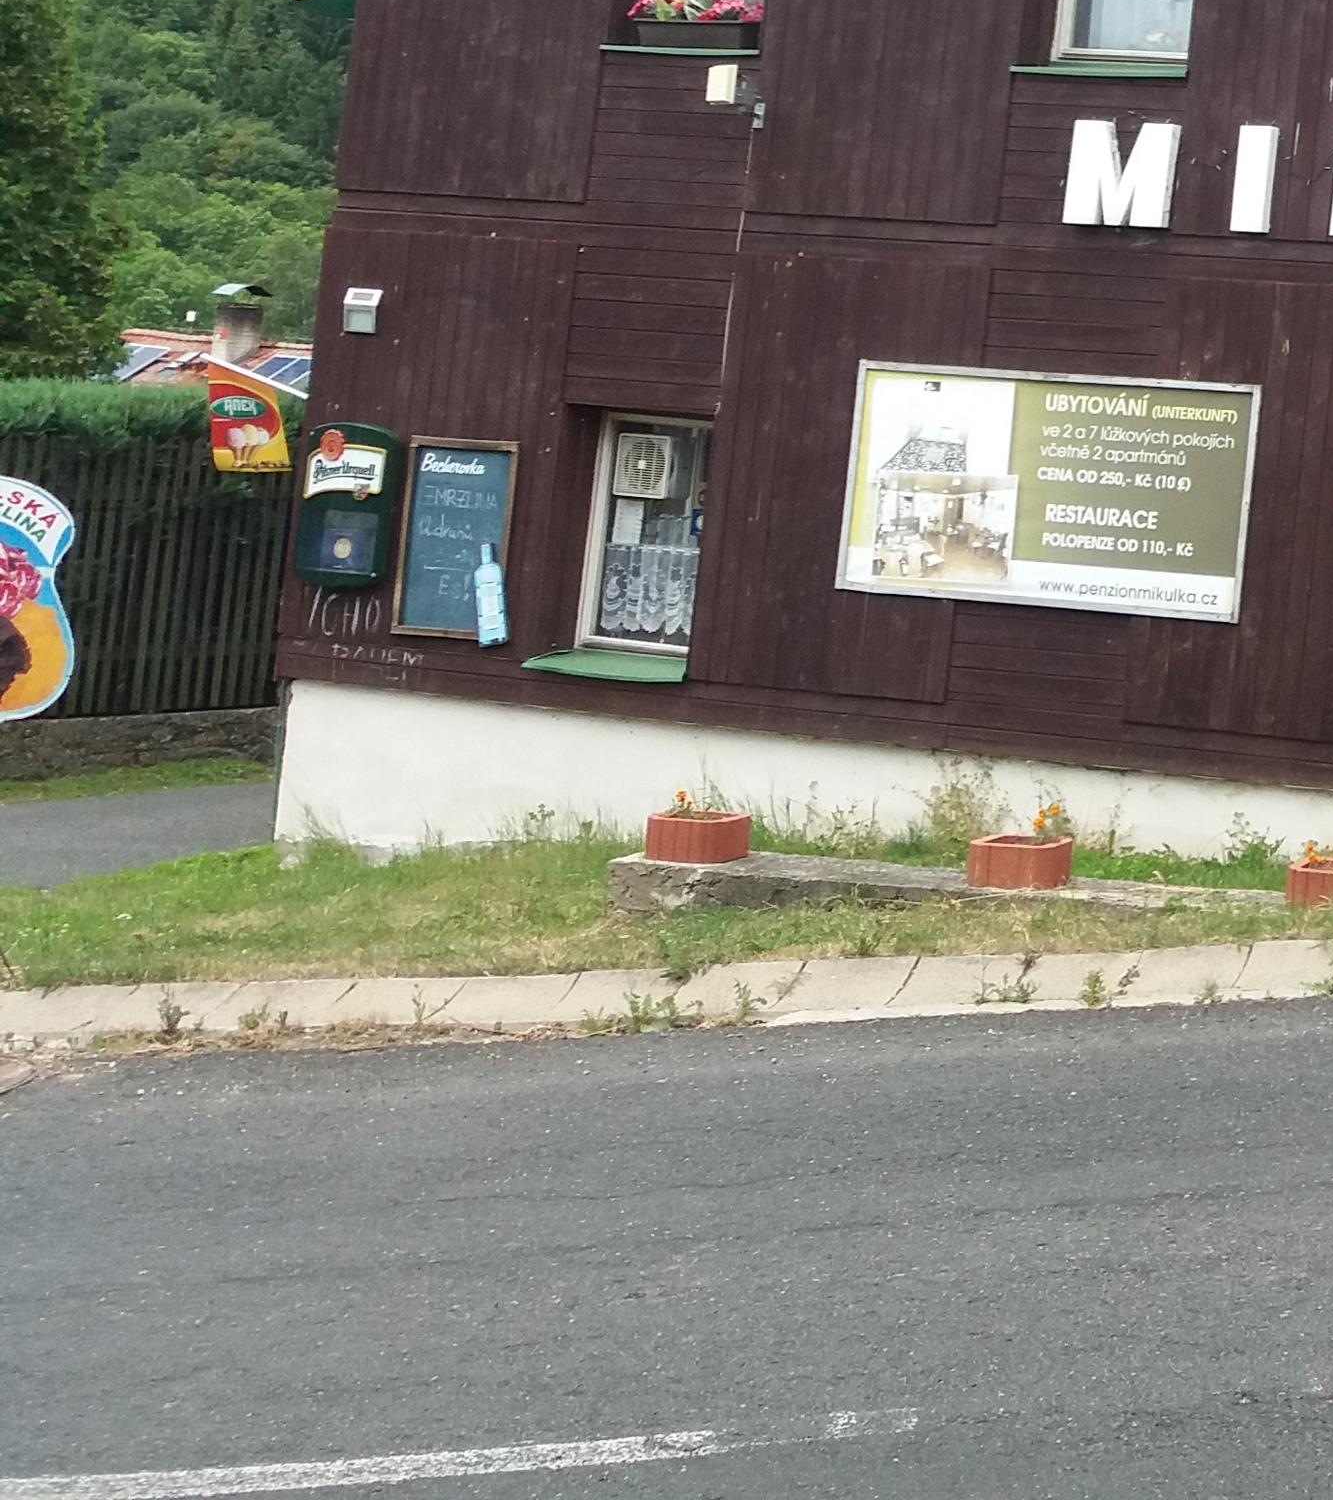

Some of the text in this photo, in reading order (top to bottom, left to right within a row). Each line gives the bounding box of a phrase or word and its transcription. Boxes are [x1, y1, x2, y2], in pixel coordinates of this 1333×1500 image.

[1045, 392, 1238, 425] UBYTOVÁNÍ (UNTERKUNFT)
[1042, 426, 1060, 438] ve
[1062, 423, 1072, 438] 2
[1074, 427, 1087, 439] a
[1088, 425, 1098, 439] 7
[1172, 431, 1235, 451] pokojích
[1040, 444, 1187, 467] včetně 2 apartmánů
[1037, 466, 1073, 482] CENA
[1076, 469, 1098, 484] OD
[1134, 472, 1152, 488] Kč
[0, 490, 61, 529] SKÁ
[0, 503, 47, 543] LINA
[1044, 503, 1159, 530] RESTAURACE
[1041, 532, 1115, 551] POLOPENZE
[1117, 537, 1139, 553] OD
[1176, 542, 1194, 557] Kč
[1039, 579, 1219, 606] www.penzionmikulka.cz
